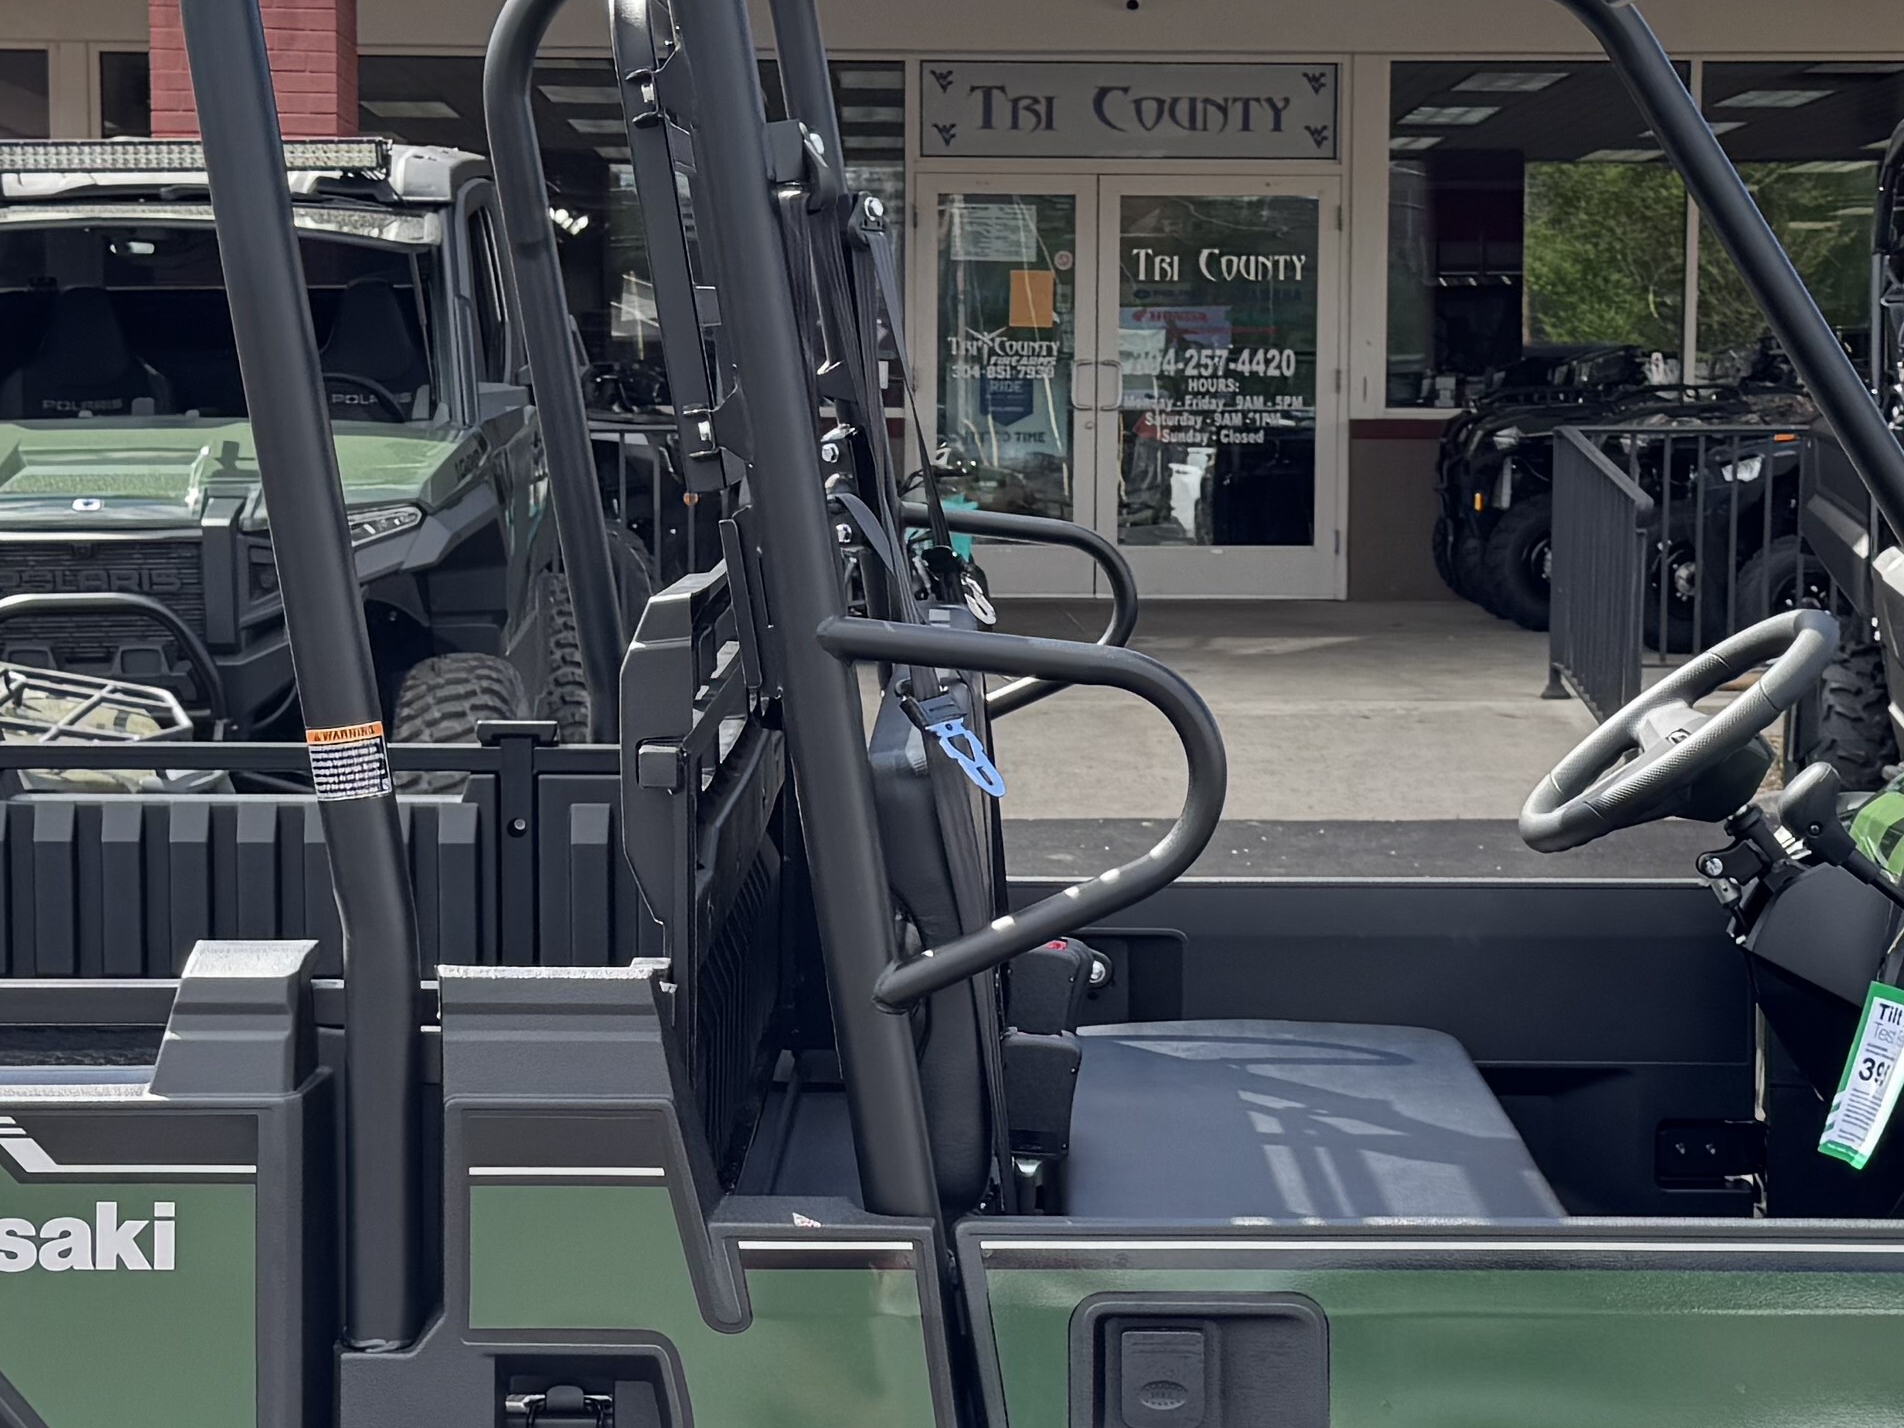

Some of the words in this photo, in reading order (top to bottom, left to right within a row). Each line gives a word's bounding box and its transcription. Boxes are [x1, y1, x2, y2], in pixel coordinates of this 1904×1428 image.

[1137, 348, 1296, 376] 04-257-4420
[1188, 378, 1239, 392] HOURS:
[1184, 395, 1225, 411] Friday
[1235, 395, 1264, 408] 9AM
[1275, 395, 1304, 408] 5PM
[1145, 412, 1203, 428] Saturday
[1214, 412, 1243, 426] 9AM
[1162, 429, 1209, 445] Sunday
[1220, 429, 1264, 443] Closed
